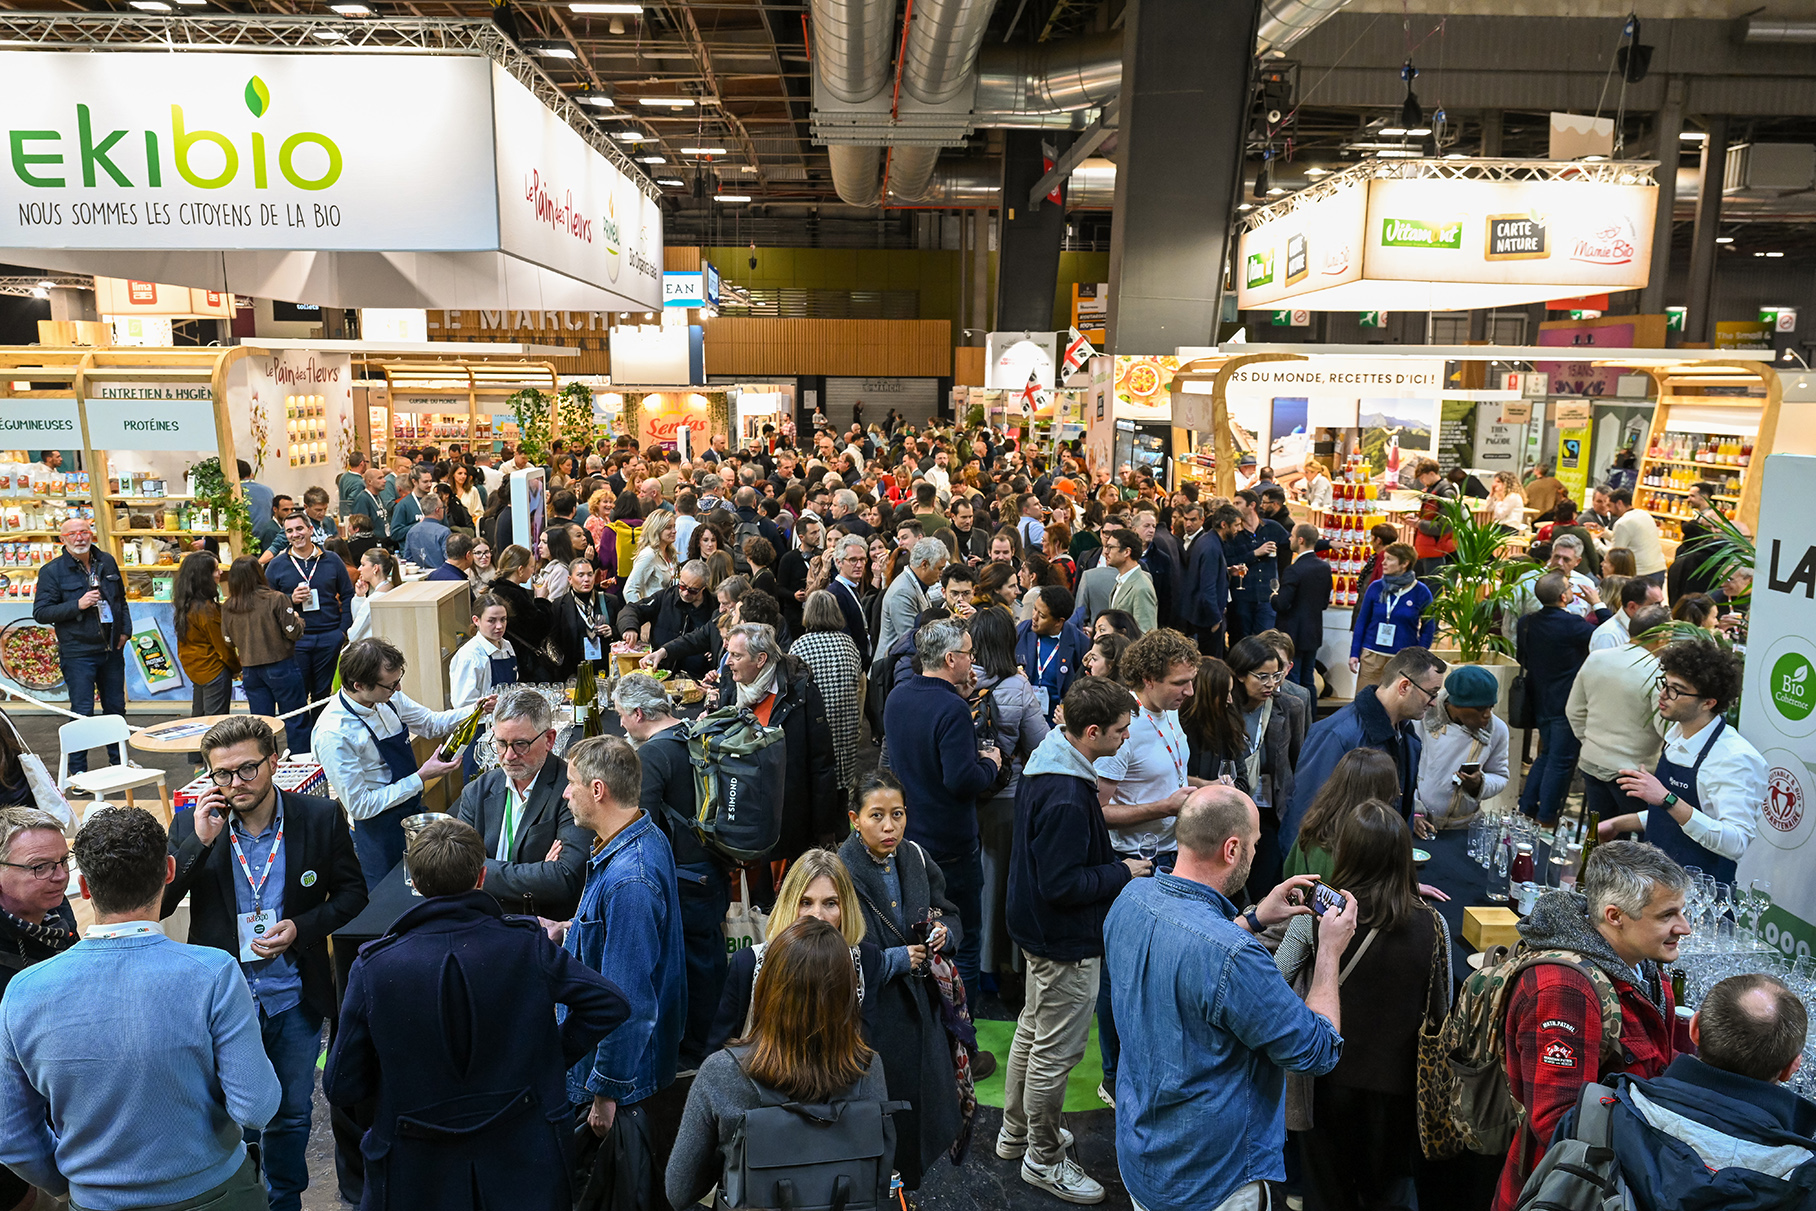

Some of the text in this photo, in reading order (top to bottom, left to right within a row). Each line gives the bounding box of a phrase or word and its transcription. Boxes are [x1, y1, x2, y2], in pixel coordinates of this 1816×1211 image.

[525, 168, 592, 244] Le Pain des fleurs
[19, 202, 341, 228] NOUS SOMMES LES CITOYENS DE LA BIO
[1386, 219, 1460, 244] Vitamont
[1497, 222, 1532, 237] CARTE
[1496, 238, 1538, 253] NATURE
[1612, 239, 1634, 259] Bio
[132, 282, 152, 292] lima
[265, 357, 339, 386] Le Pain des fleurs
[1251, 372, 1269, 382] DU
[1274, 372, 1325, 384] MONDE,
[1329, 373, 1392, 384] RECETTES
[1431, 374, 1435, 384] !
[102, 388, 162, 399] ENTRETIEN
[165, 389, 173, 399] &
[124, 417, 180, 431] PROTÉINES
[1782, 674, 1805, 697] Bio
[1775, 691, 1809, 711] Cohérence
[728, 777, 738, 812] SIMOND
[304, 874, 316, 886] BIO
[246, 912, 269, 924] natexpo
